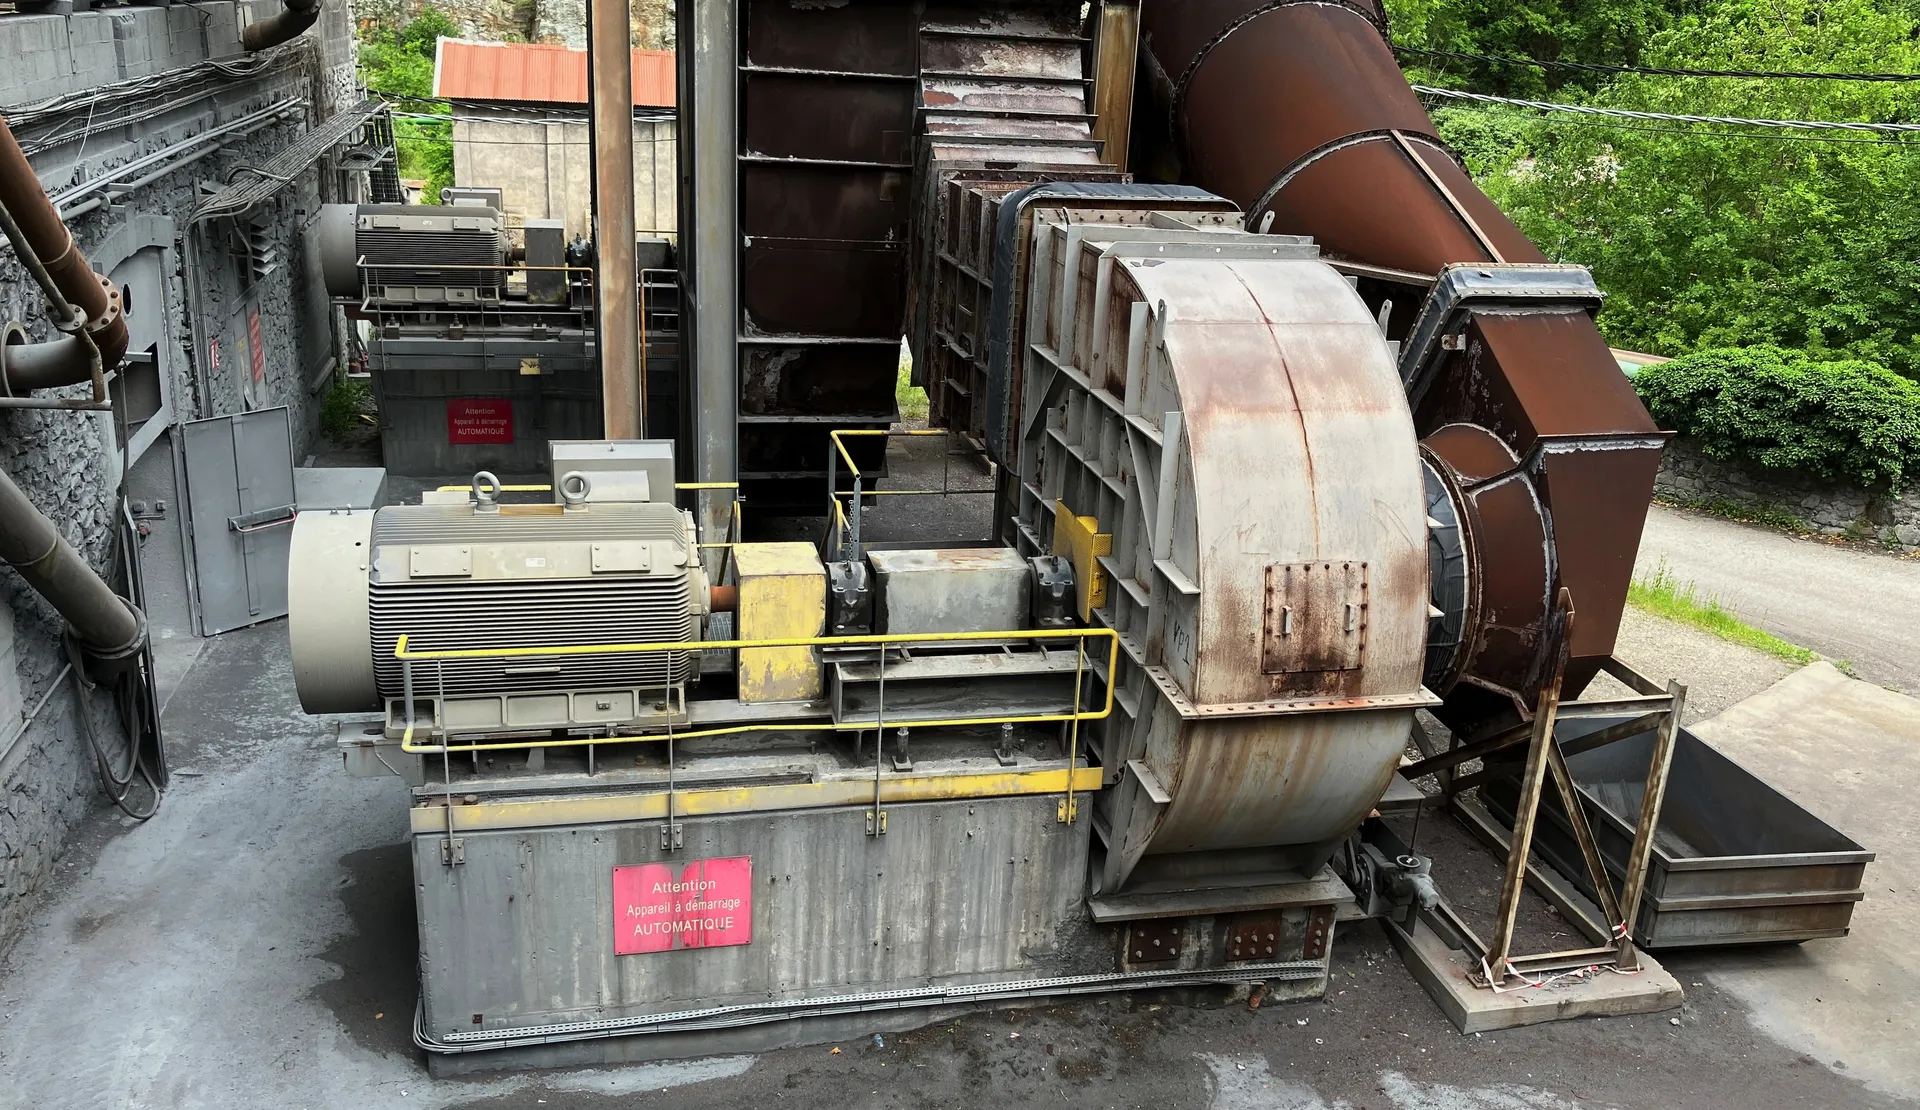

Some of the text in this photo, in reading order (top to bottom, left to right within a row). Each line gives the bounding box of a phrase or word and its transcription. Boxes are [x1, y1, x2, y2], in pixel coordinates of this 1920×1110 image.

[481, 418, 507, 426] démarrage
[652, 879, 716, 894] Attention
[627, 898, 741, 917] Appareil à démarrage
[633, 916, 734, 936] AUTOMATIQUE
